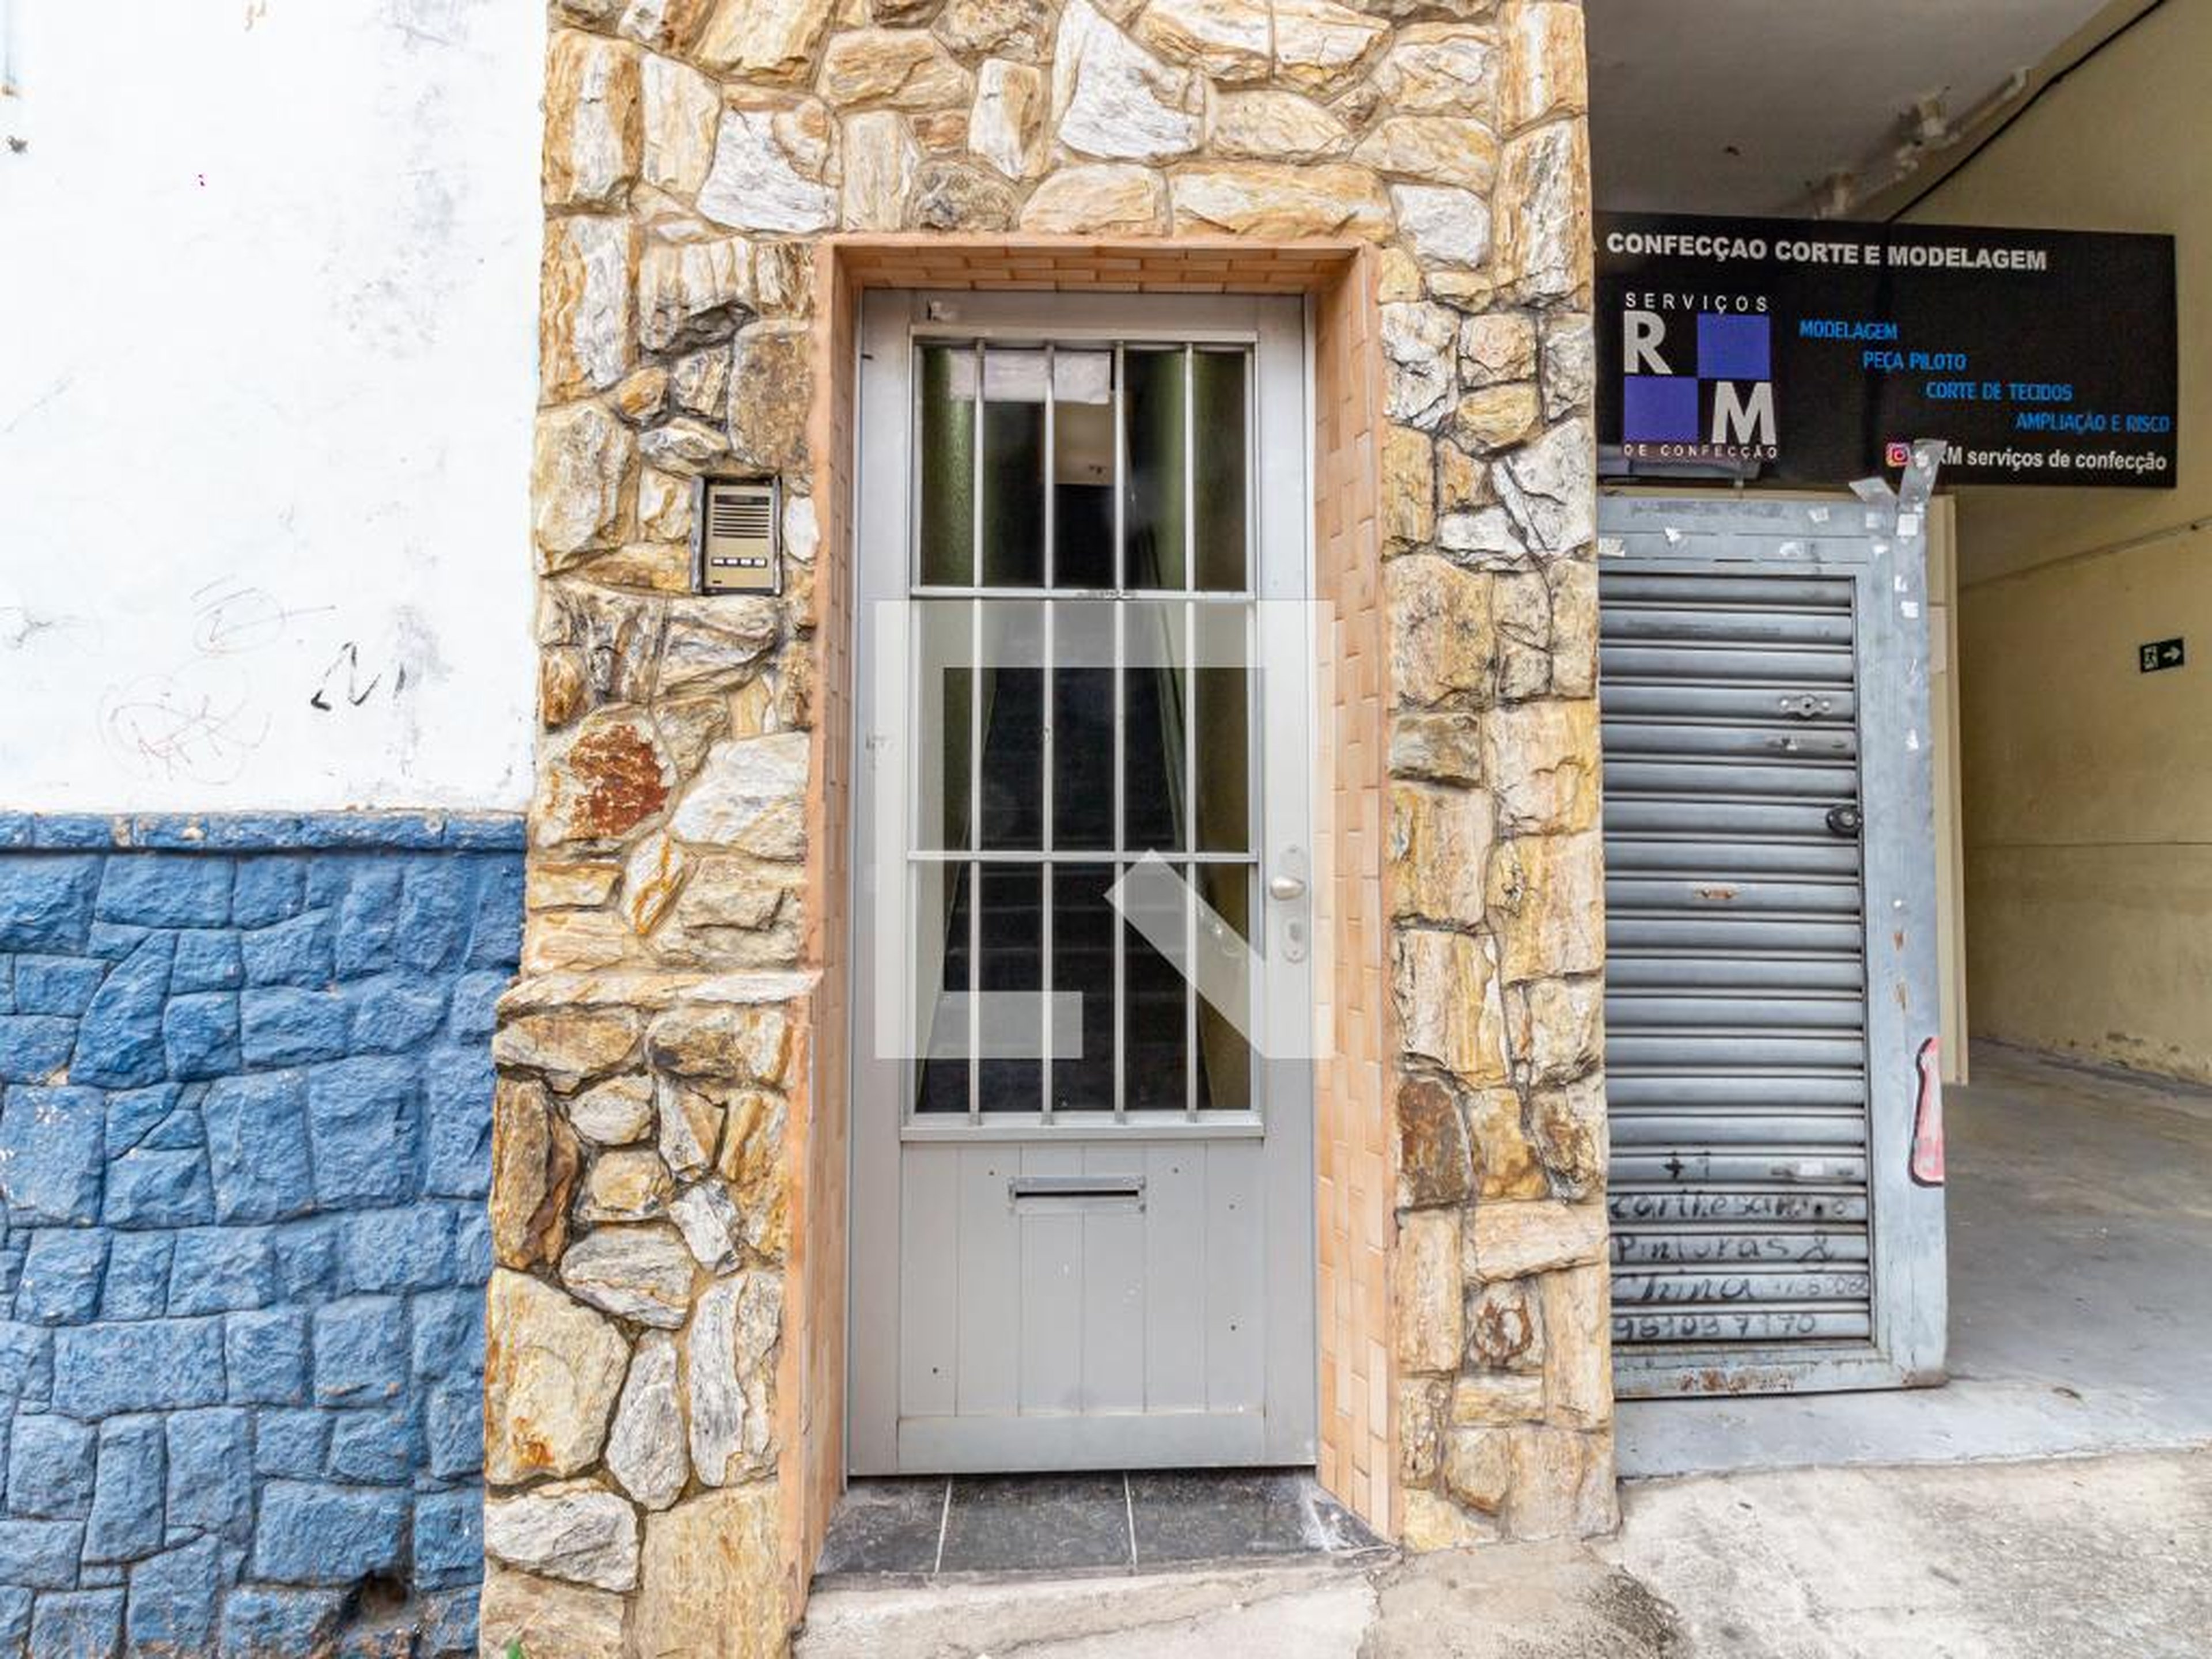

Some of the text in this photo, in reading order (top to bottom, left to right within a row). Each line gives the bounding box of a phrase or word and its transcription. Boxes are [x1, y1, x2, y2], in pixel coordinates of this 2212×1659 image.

[1775, 241, 1859, 264] CORTE
[1864, 245, 1880, 264] E
[1888, 245, 2048, 271] MODELAGEM
[1624, 292, 1768, 314] SERVIÇOS
[1799, 319, 1898, 340] MODELAGEM
[1624, 310, 1673, 374] R
[1863, 350, 1967, 373] PEÇA PILOTO
[1926, 381, 2073, 402] CORTE DE TECIDOS
[1711, 381, 1777, 445] M
[2016, 410, 2171, 434] AMPLIAÇÃO E RISCO
[1624, 444, 1647, 456] DE
[1967, 447, 2043, 471] serviços
[2048, 449, 2070, 467] de
[2075, 450, 2167, 474] confecção
